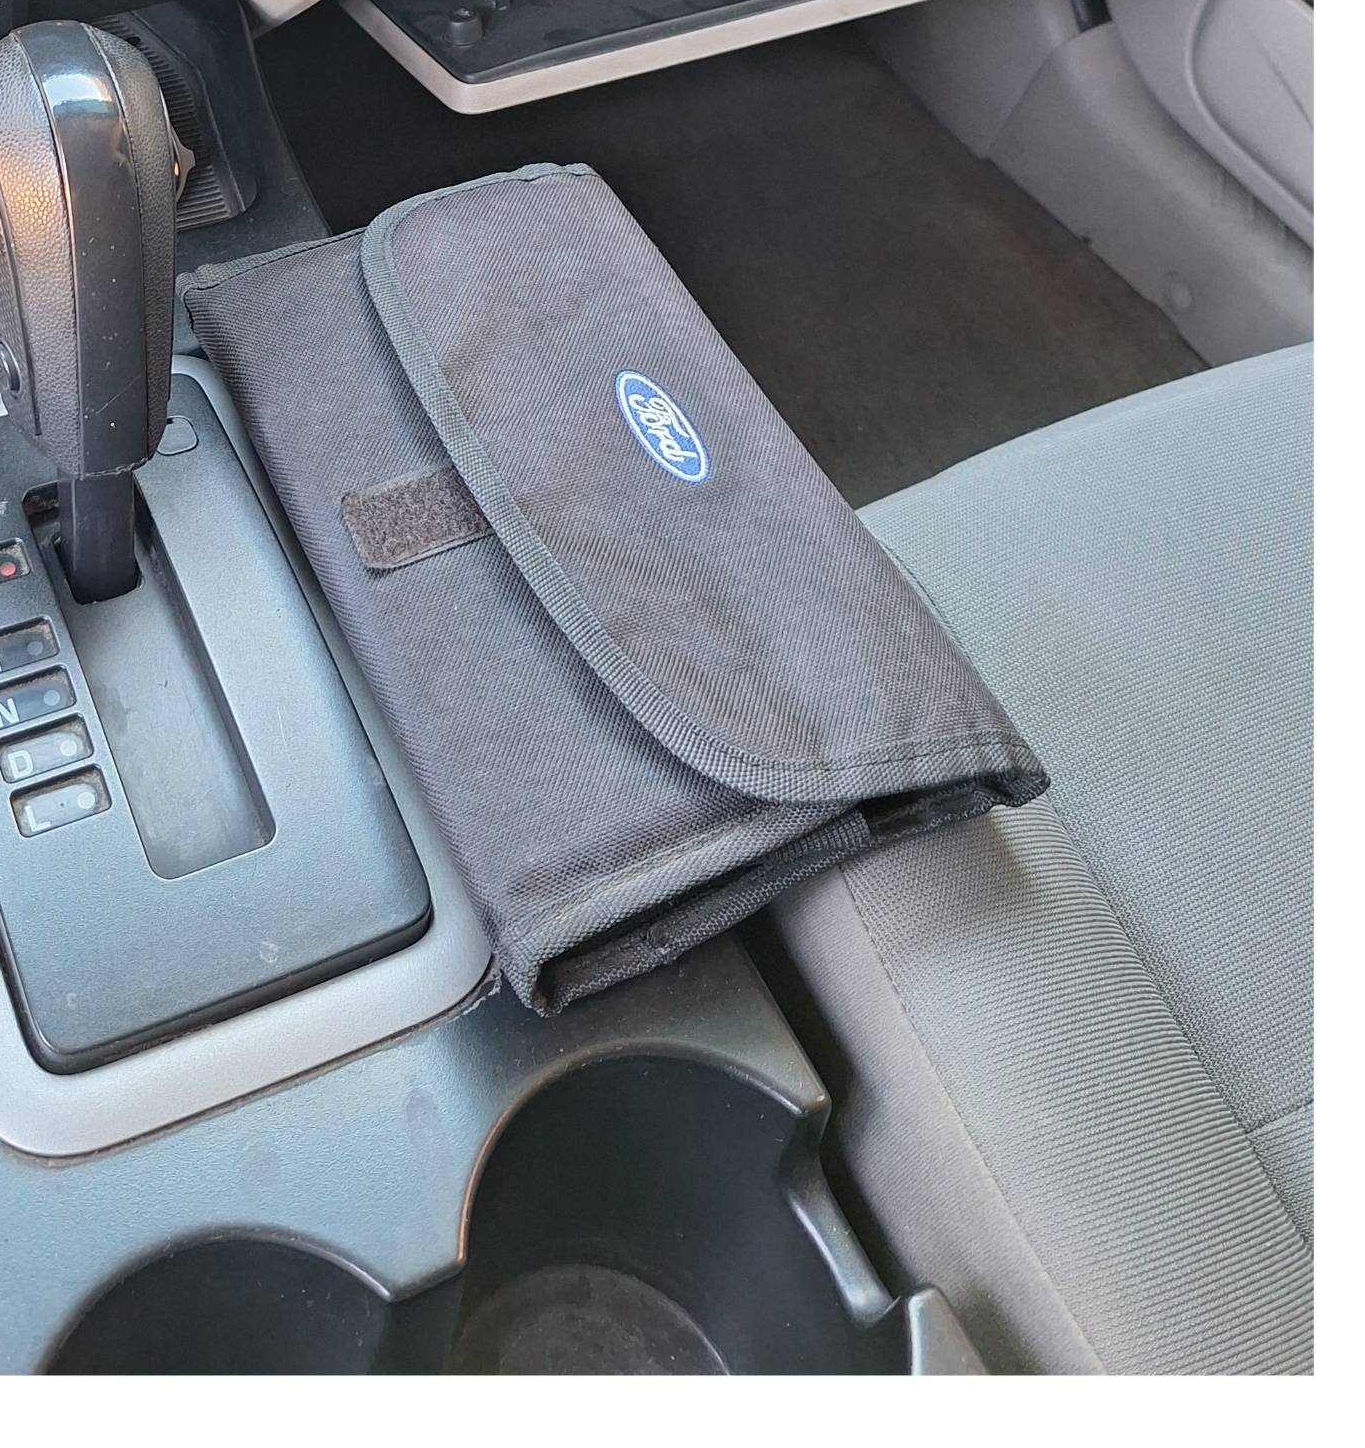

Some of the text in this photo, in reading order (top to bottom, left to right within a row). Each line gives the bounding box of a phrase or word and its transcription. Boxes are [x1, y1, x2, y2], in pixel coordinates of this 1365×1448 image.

[629, 393, 699, 463] Ford
[8, 749, 34, 780] D
[23, 805, 51, 833] L
